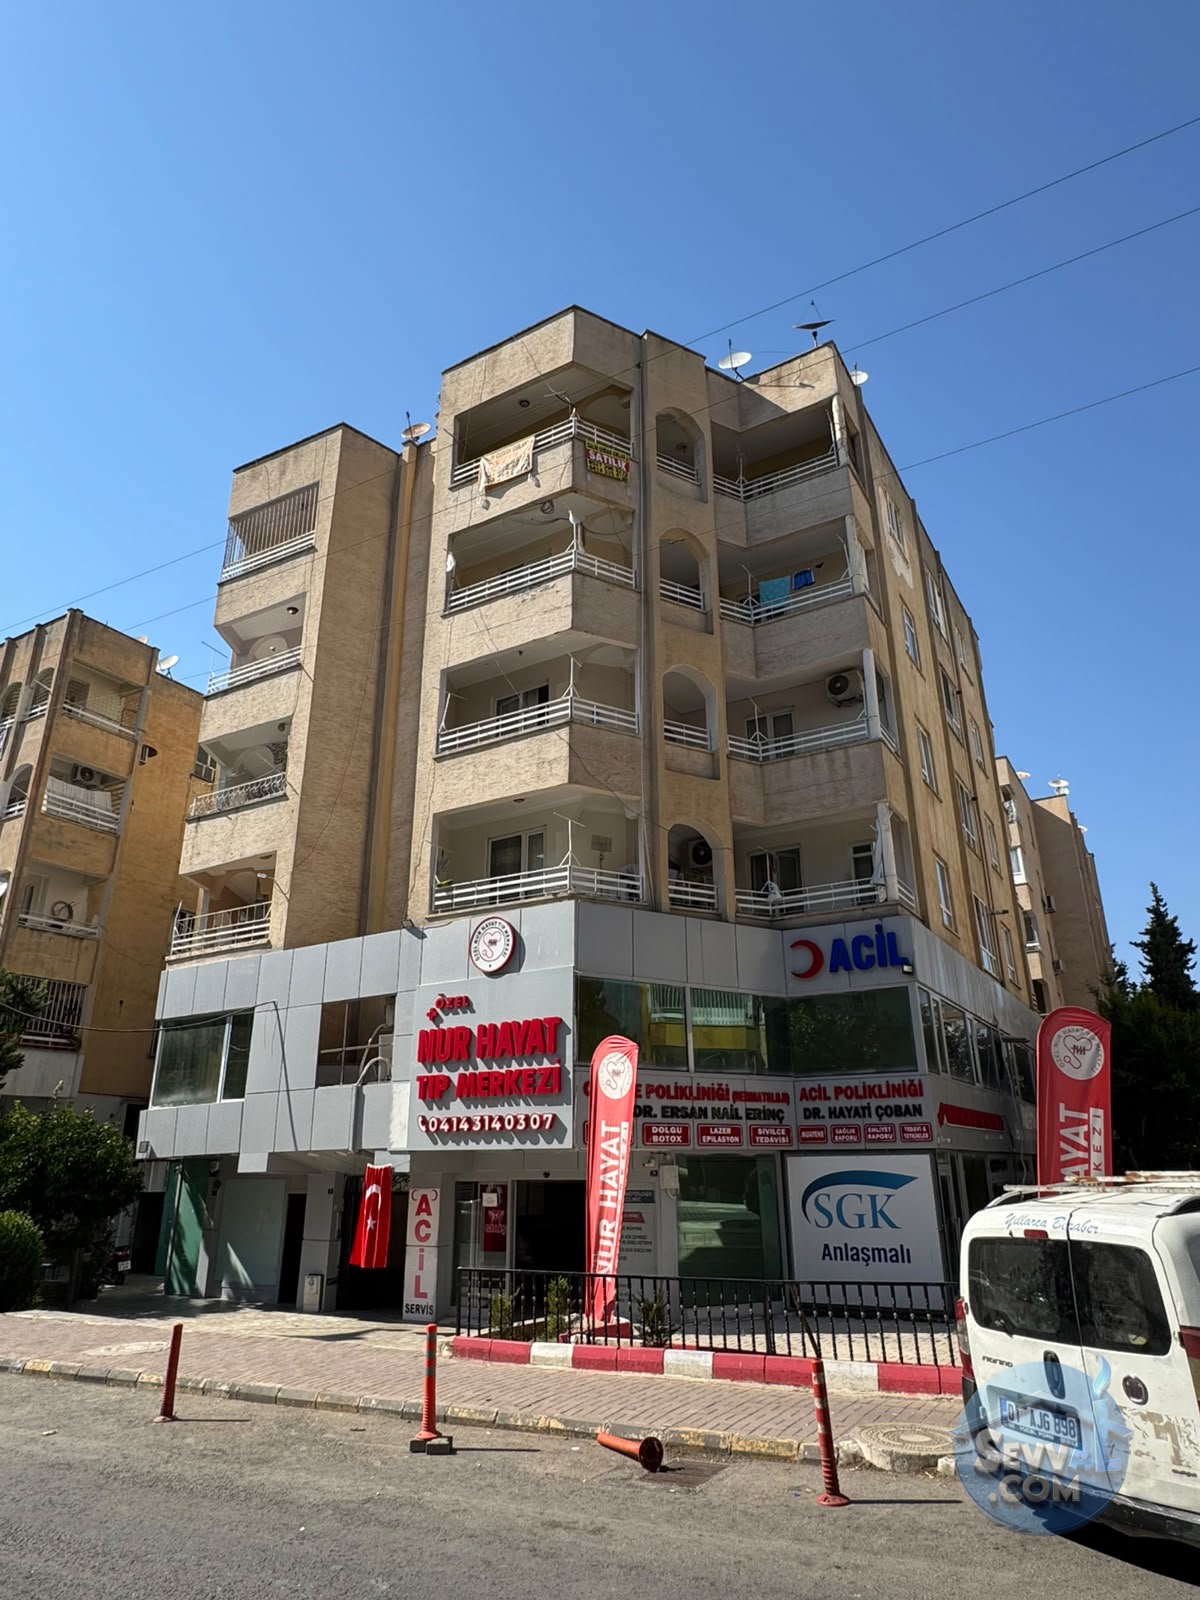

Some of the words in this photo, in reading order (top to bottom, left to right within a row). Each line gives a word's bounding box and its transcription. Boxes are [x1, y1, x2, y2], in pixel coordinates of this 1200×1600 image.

[589, 450, 627, 472] SATILIK
[829, 924, 910, 973] ACİL
[435, 993, 471, 1010] ÖZEL
[417, 1026, 472, 1063] NUR
[476, 1016, 562, 1059] HAYAT
[416, 1073, 450, 1100] TIP
[455, 1058, 562, 1099] MERKEZİ
[800, 1084, 831, 1102] ACİL
[834, 1079, 924, 1100] POLİKLİNİĞİ
[646, 1081, 730, 1101] POLİKLİNİĞİ
[661, 1106, 709, 1120] ERSAN
[711, 1104, 743, 1120] NAİL
[745, 1105, 785, 1124] ERİNÇ
[804, 1107, 825, 1120] DR.
[828, 1103, 872, 1119] HAYATİ
[875, 1104, 923, 1121] ÇOBAN
[652, 1126, 682, 1134] DOLGU
[652, 1134, 682, 1143] BOTOX
[710, 1127, 731, 1135] LAZER
[1059, 1103, 1089, 1180] AYAT
[599, 1120, 621, 1209] HAYAT
[814, 1193, 901, 1230] SGK
[414, 1193, 432, 1298] ACİL
[822, 1243, 911, 1266] Anlaşmalı
[404, 1302, 434, 1316] SERVİS
[1030, 1409, 1051, 1432] AJG
[1054, 1418, 1077, 1438] 898
